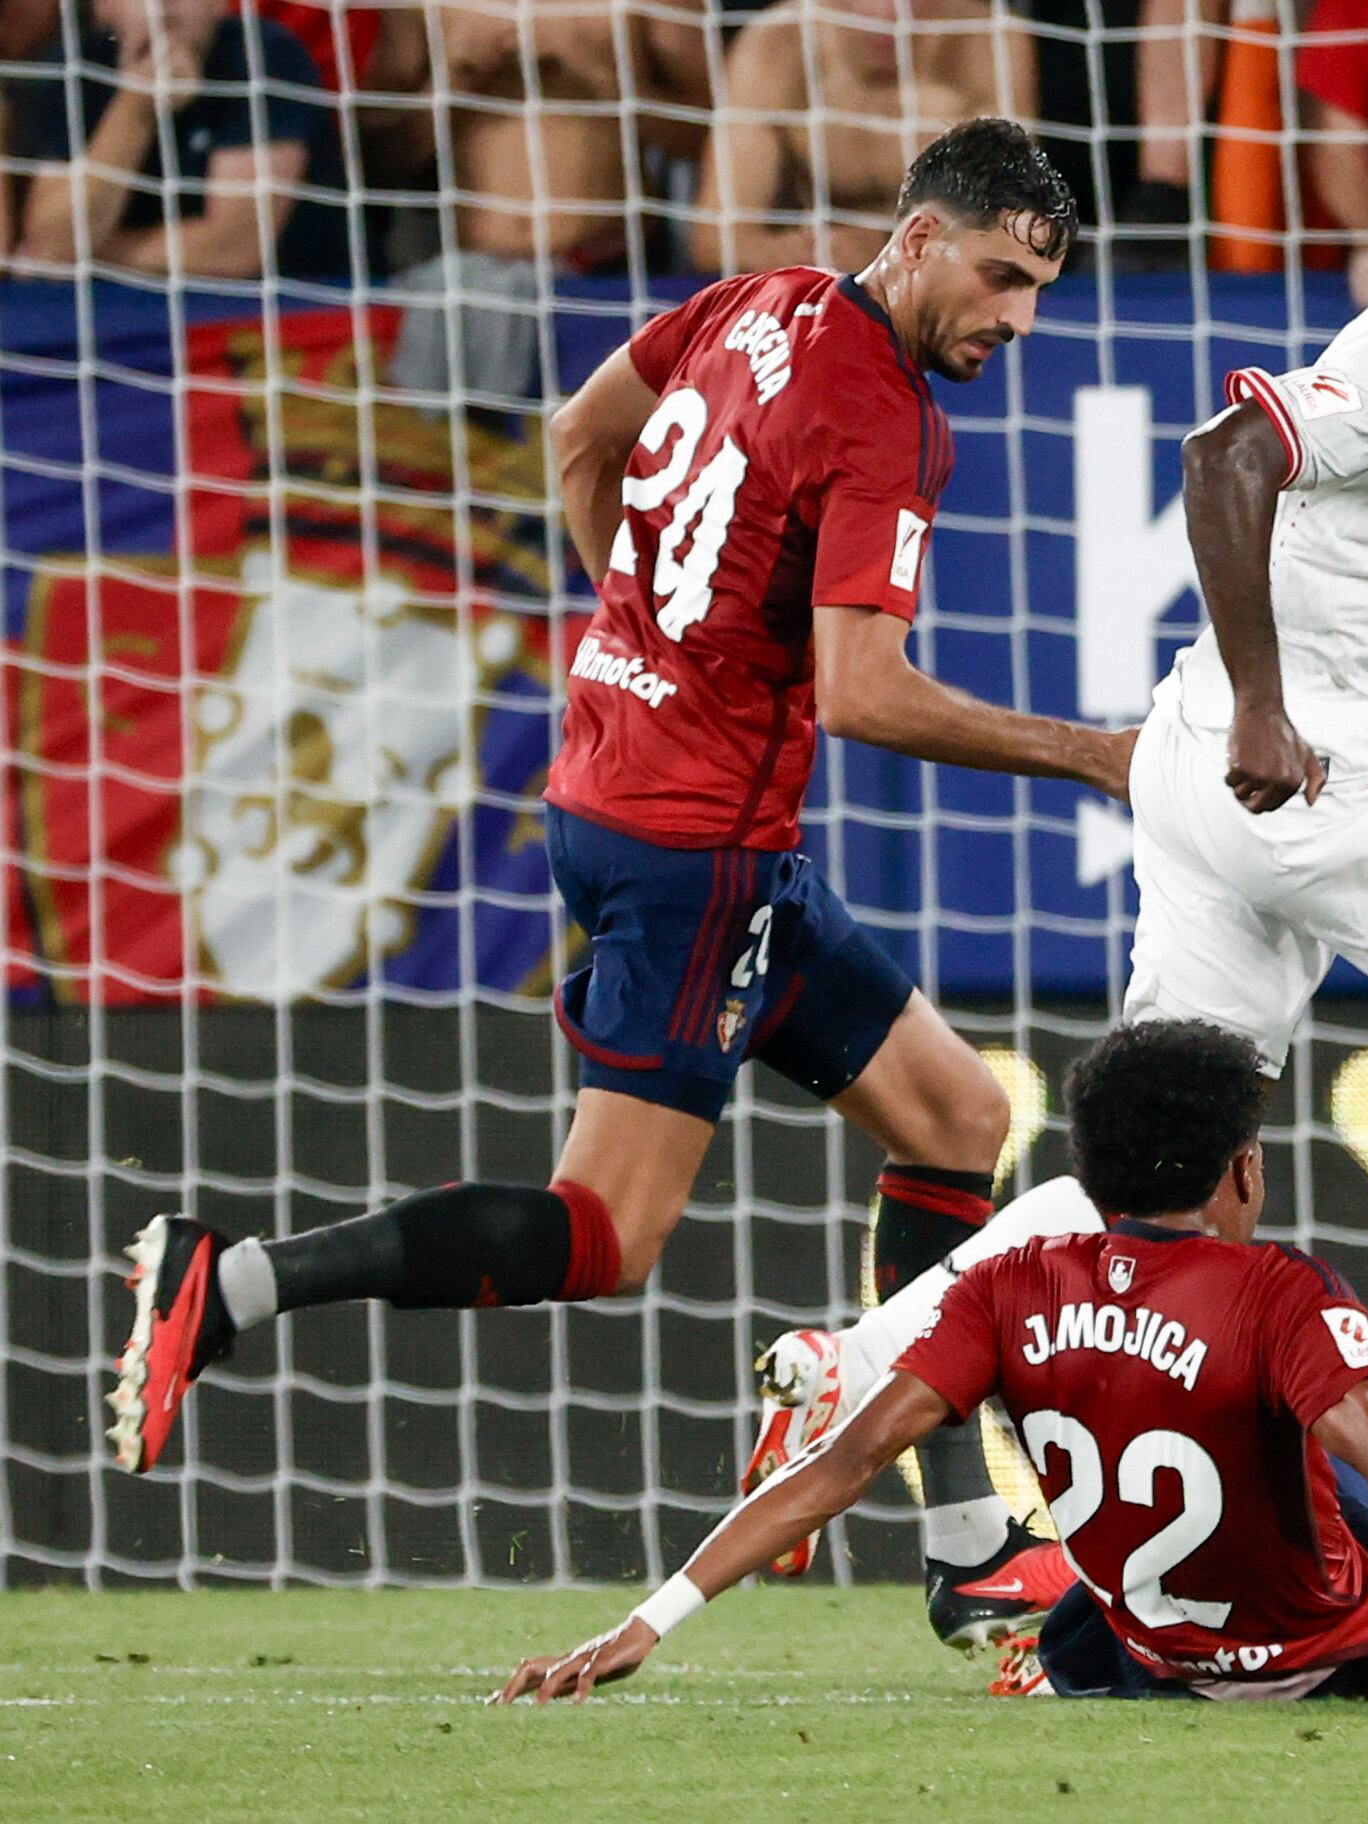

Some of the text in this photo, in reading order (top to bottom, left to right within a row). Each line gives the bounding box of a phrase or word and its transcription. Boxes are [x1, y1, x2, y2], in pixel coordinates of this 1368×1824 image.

[610, 387, 748, 642] 24
[1022, 1302, 1208, 1392] J.MOJICA
[1022, 1409, 1233, 1630] 22
